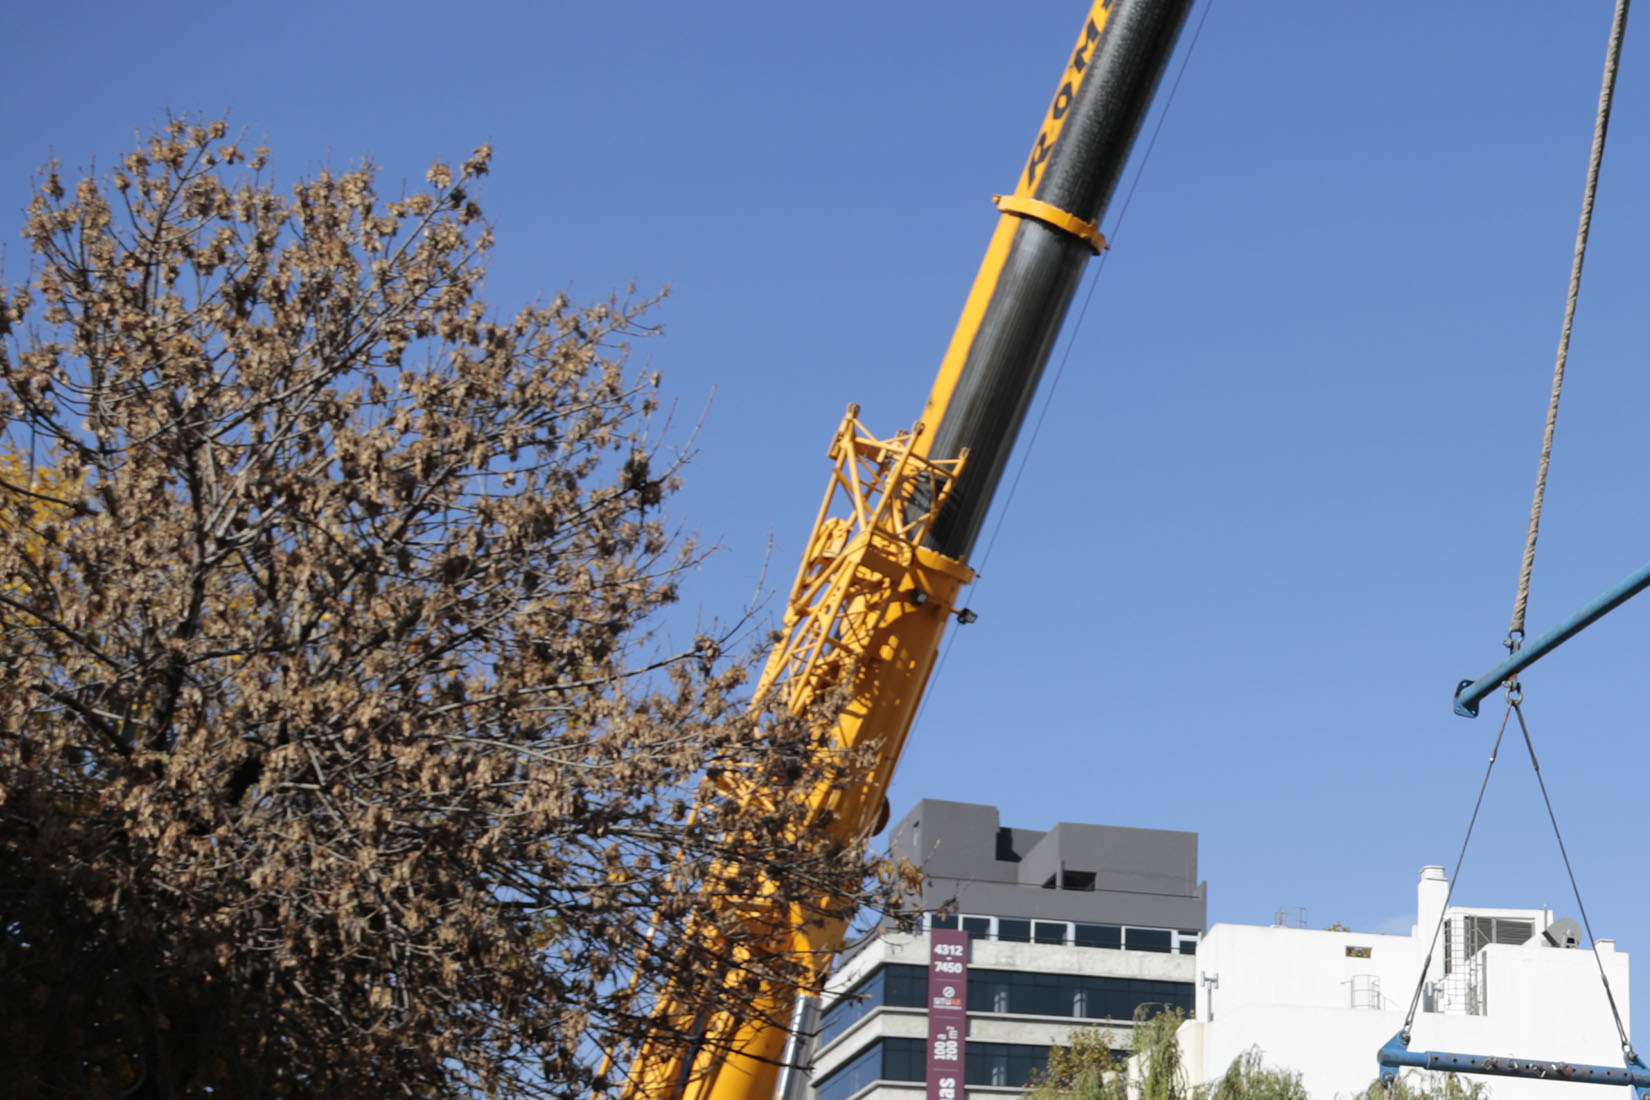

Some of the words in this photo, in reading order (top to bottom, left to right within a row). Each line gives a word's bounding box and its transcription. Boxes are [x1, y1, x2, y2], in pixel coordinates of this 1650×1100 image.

[1028, 0, 1113, 188] ROM
[934, 944, 964, 956] 4312
[934, 961, 963, 974] 7450
[934, 1041, 946, 1060] 100
[946, 1040, 959, 1060] 200
